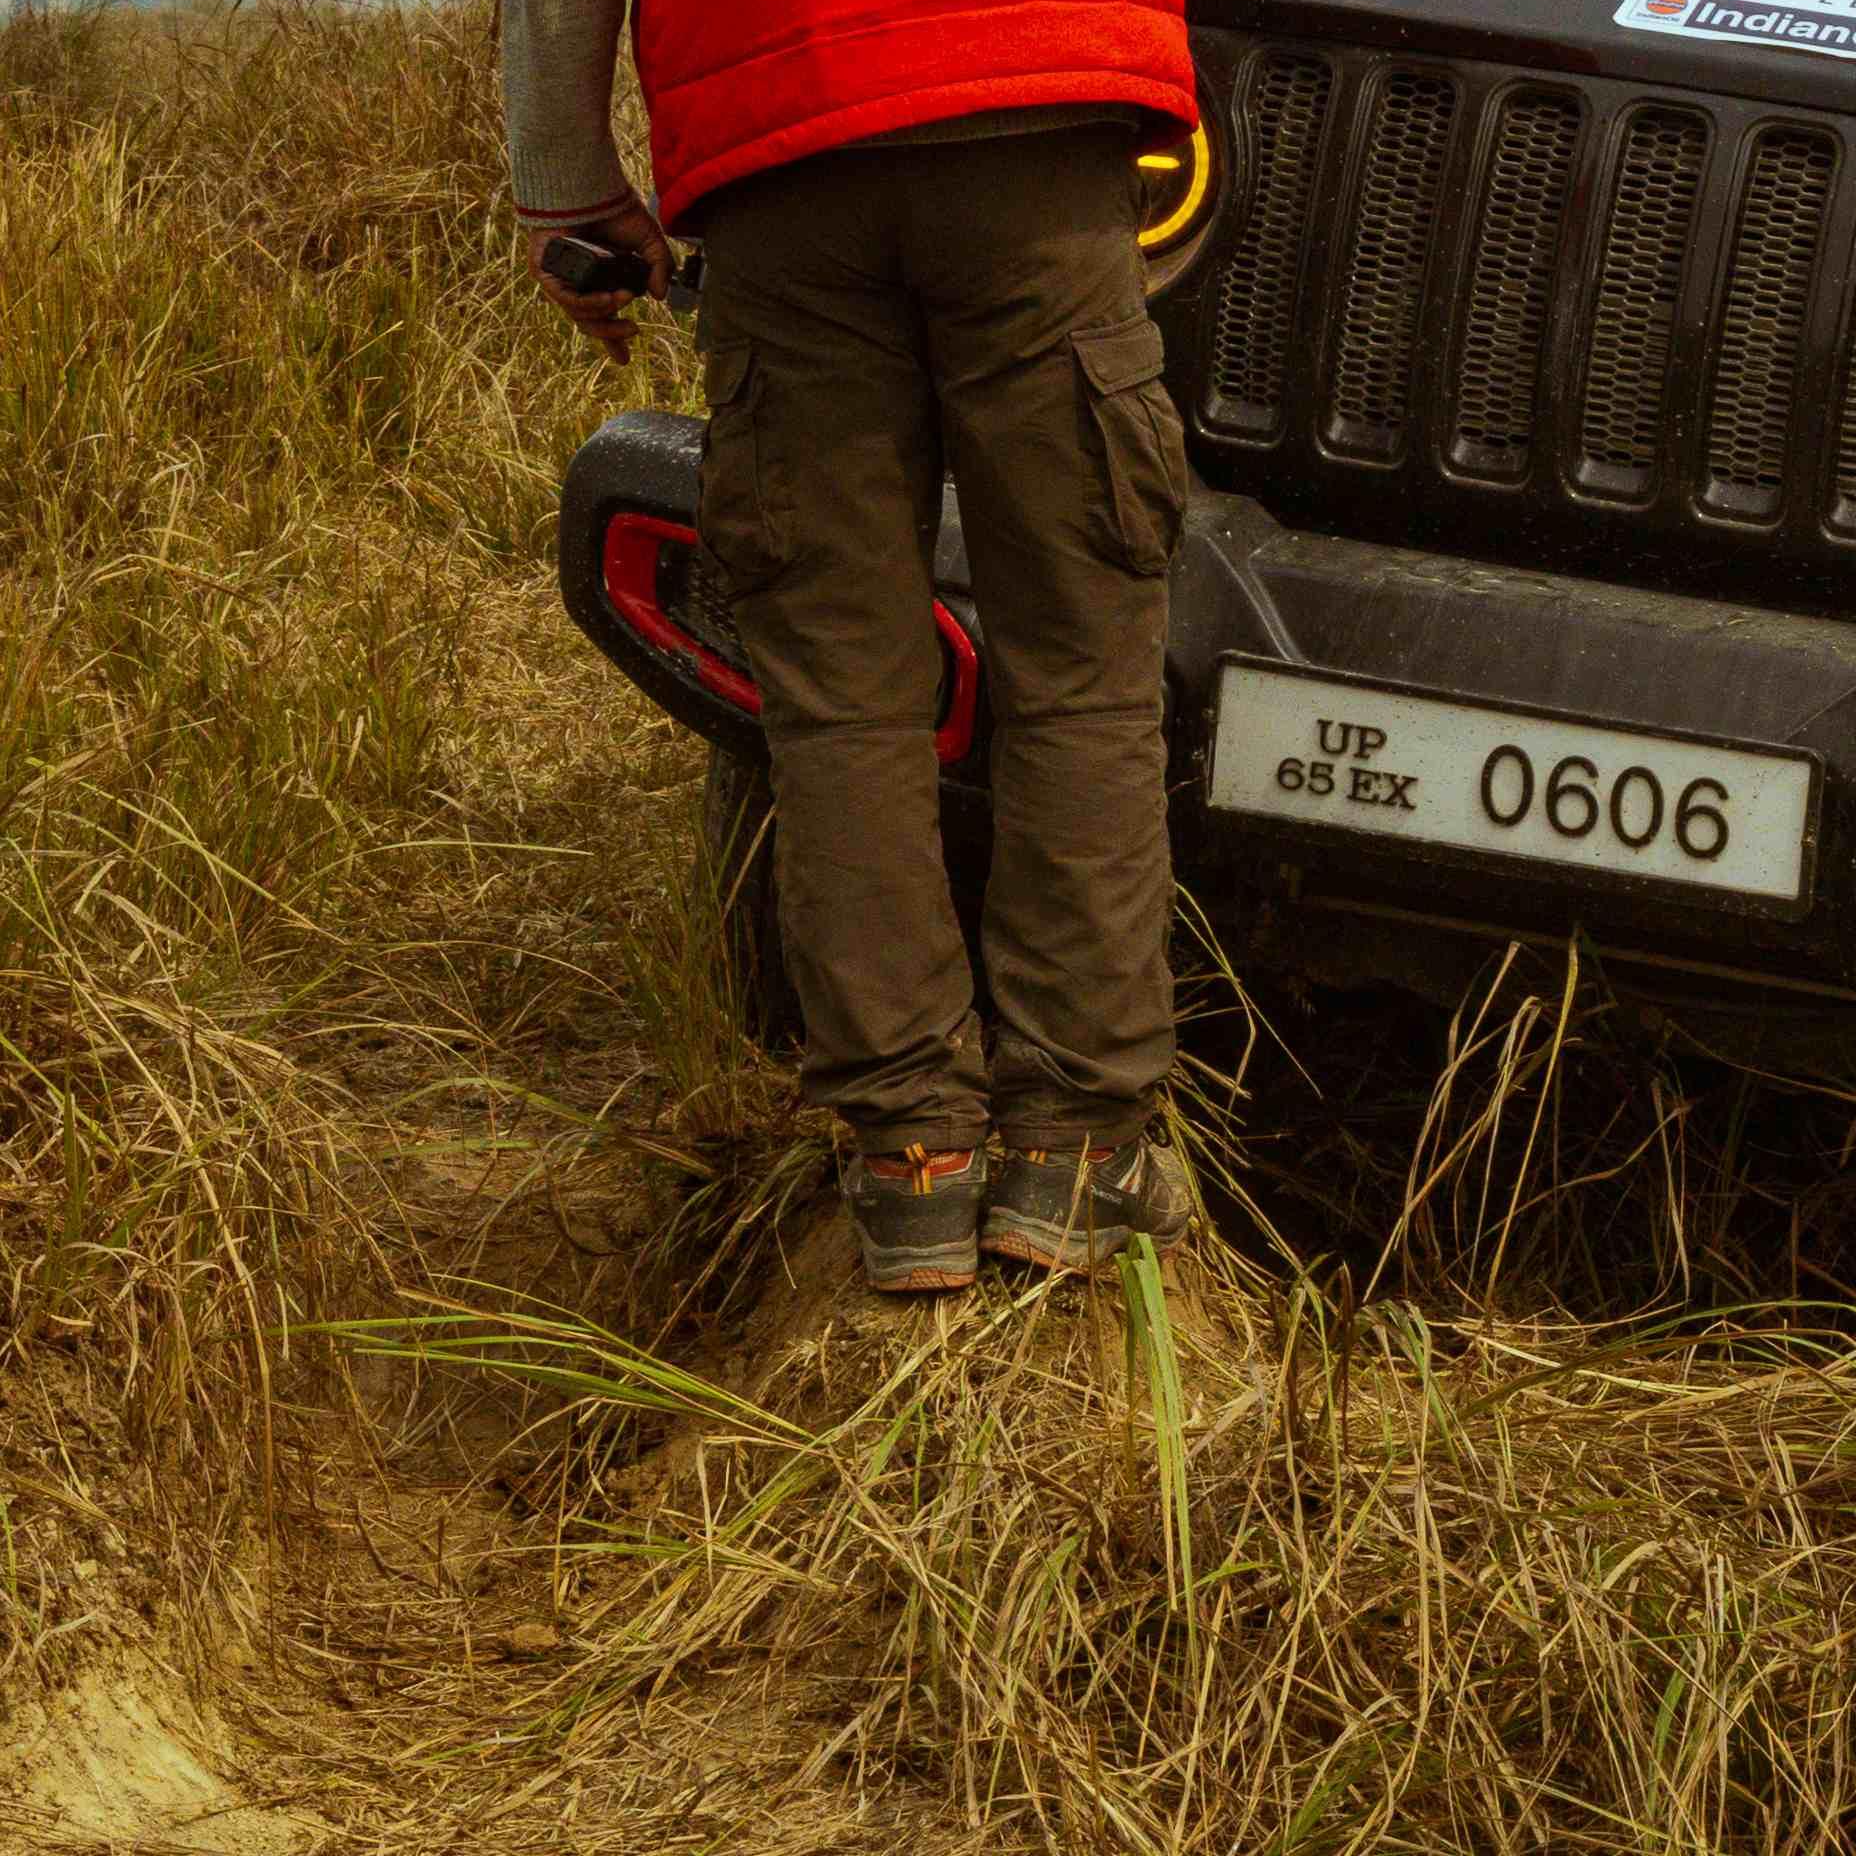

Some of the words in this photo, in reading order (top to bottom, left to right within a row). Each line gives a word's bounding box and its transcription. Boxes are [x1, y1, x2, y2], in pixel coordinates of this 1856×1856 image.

[1316, 718, 1388, 762] UP
[1276, 756, 1336, 796] 65
[1345, 768, 1418, 811] EX
[1480, 744, 1731, 860] 0606
